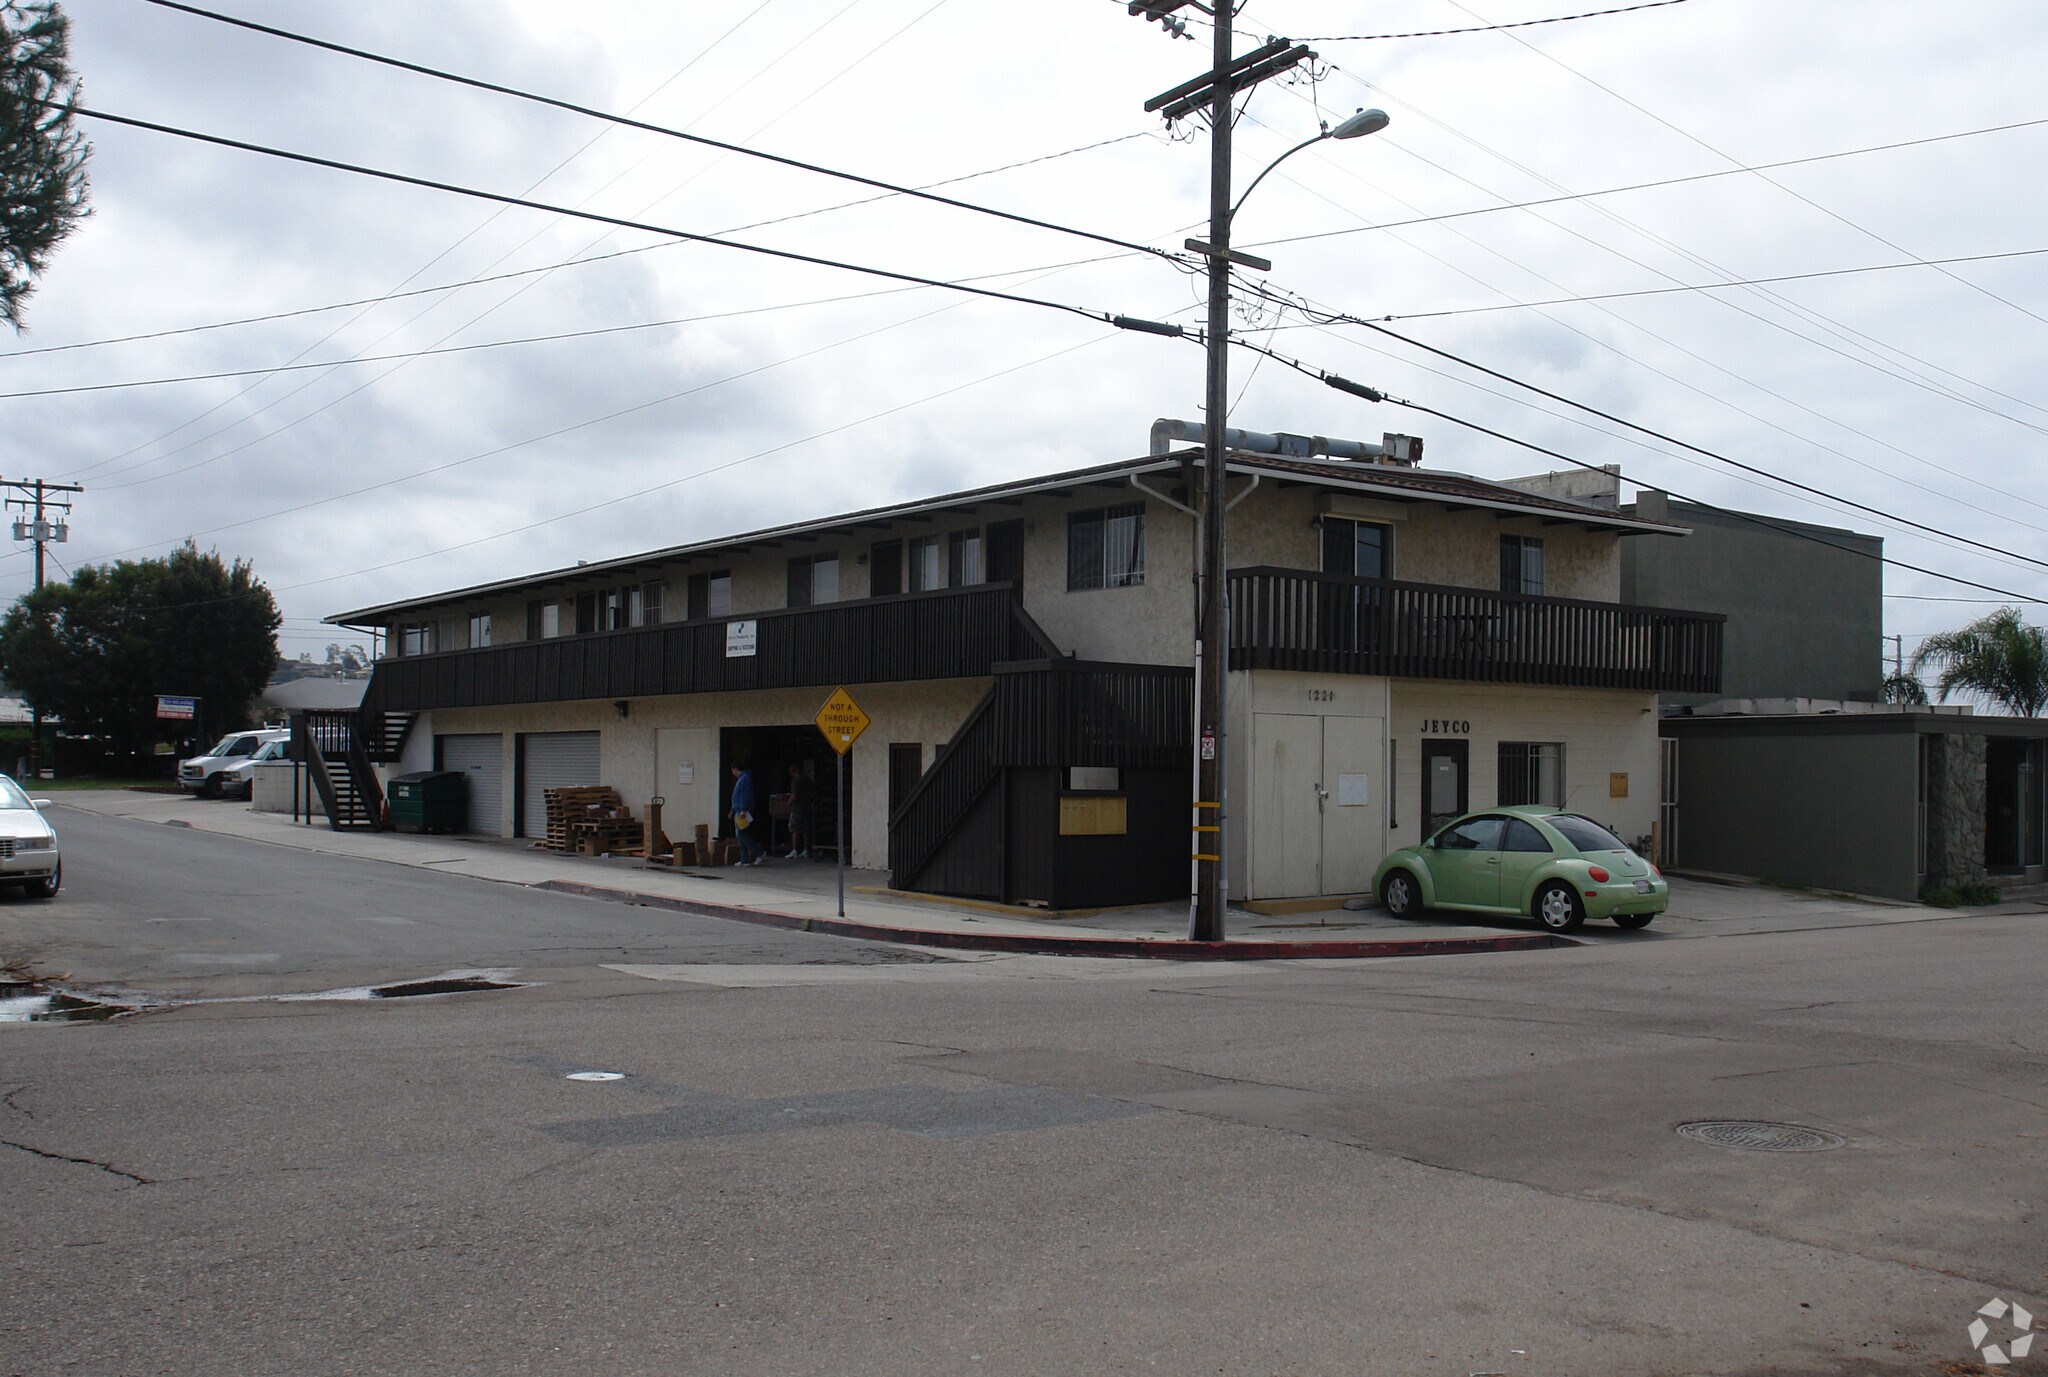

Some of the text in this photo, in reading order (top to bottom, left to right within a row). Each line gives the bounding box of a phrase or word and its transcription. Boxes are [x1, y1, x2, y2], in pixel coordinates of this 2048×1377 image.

[830, 703, 853, 711] NOT A
[824, 714, 859, 723] THROUGH
[828, 725, 855, 734] STREET
[1420, 719, 1470, 734] JEYCO
